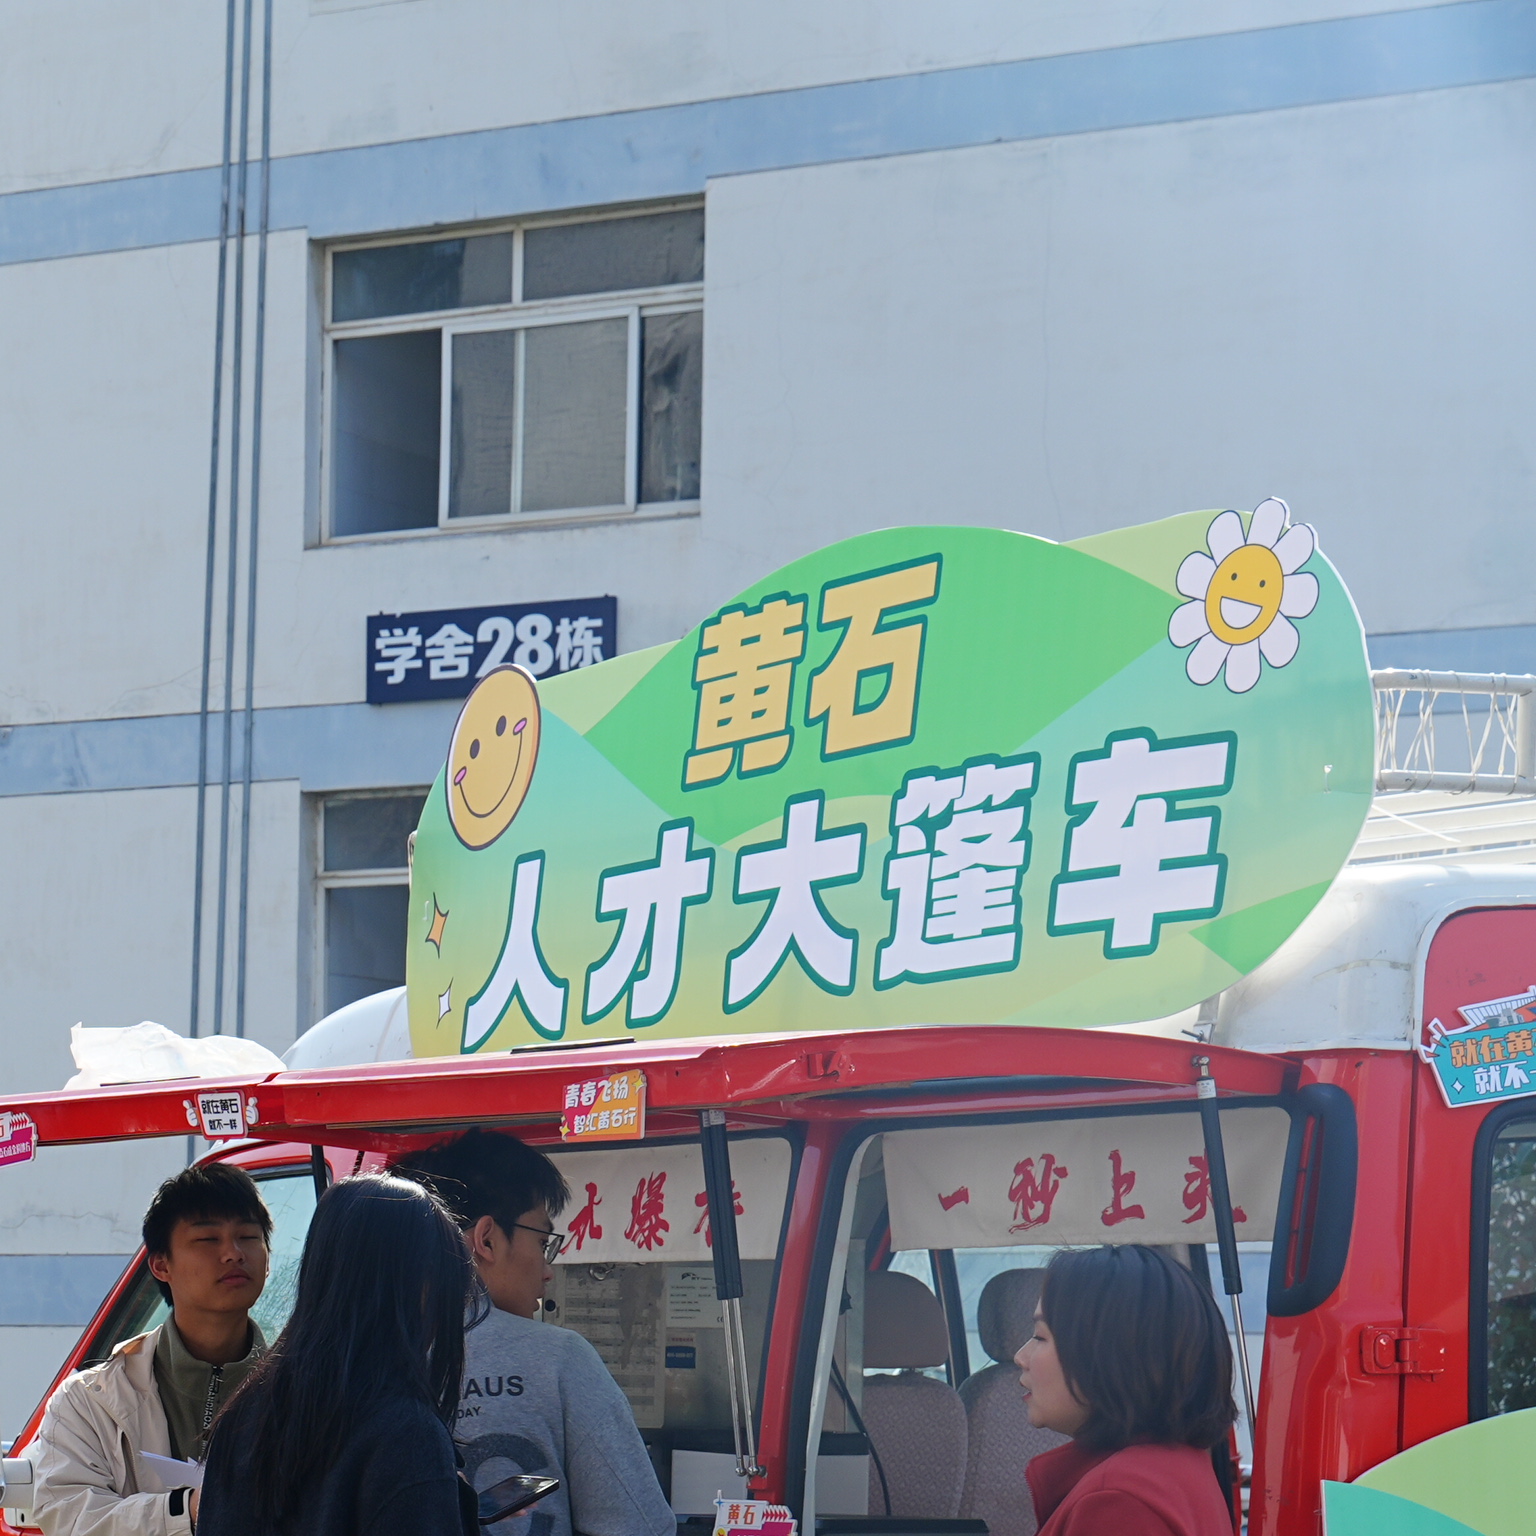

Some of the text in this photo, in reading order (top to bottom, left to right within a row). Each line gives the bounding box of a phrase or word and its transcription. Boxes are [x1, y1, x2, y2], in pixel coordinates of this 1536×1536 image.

[374, 613, 604, 684] 学舍28栋
[681, 551, 943, 791] 黄石
[460, 728, 1237, 1055] 人才大篷车
[1450, 1029, 1536, 1068] 就在黄
[565, 1076, 629, 1109] 青春飞扬
[1473, 1060, 1536, 1095] 就不
[201, 1099, 239, 1114] 就在黄石
[574, 1107, 637, 1134] 智汇黄石行
[727, 1504, 756, 1525] 黄石
